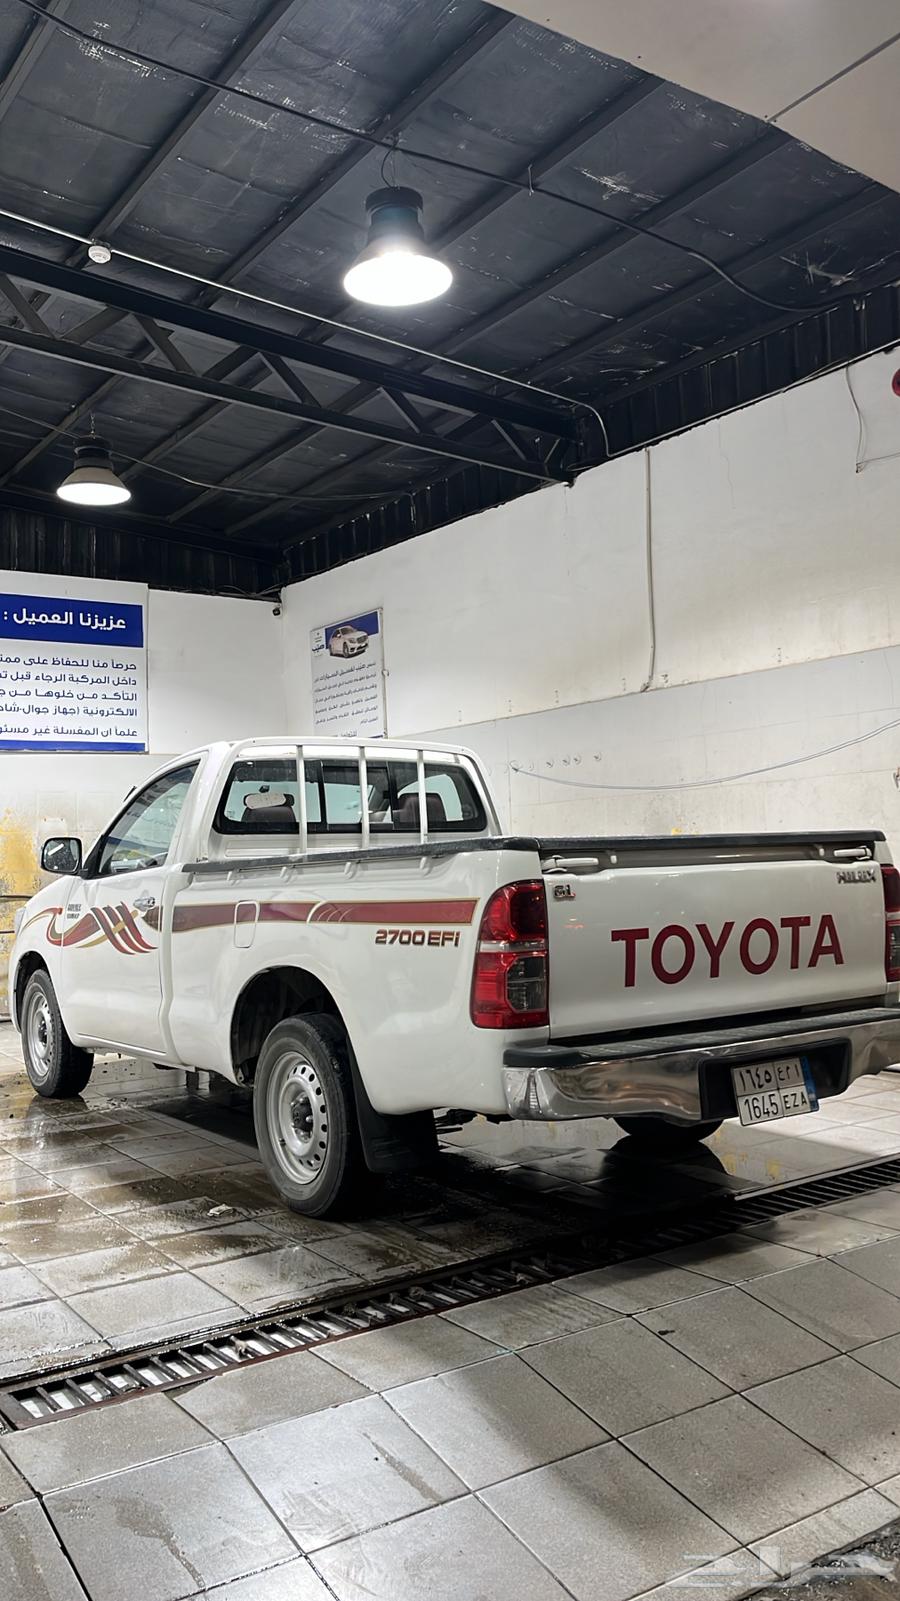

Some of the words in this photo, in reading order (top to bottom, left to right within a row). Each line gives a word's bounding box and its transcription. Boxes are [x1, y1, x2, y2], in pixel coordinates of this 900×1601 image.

[13, 608, 73, 625] العميل
[79, 612, 126, 630] عزيزنا
[23, 656, 49, 666] على
[51, 657, 89, 667] للحفاظ
[92, 660, 109, 668] منا
[10, 671, 31, 682] قبل
[34, 672, 66, 683] الرجاء
[68, 673, 110, 685] المركبة
[112, 676, 137, 686] داخل
[35, 688, 74, 699] خلوها
[76, 692, 98, 701] من
[82, 706, 137, 717] الالكترونية
[32, 725, 51, 737] غير
[53, 726, 99, 737] المغسلة
[101, 728, 112, 737] ان
[375, 929, 426, 946] 2700
[611, 914, 845, 988] TOYOTA
[744, 1093, 778, 1120] 1645
[783, 1092, 807, 1109] EZA
